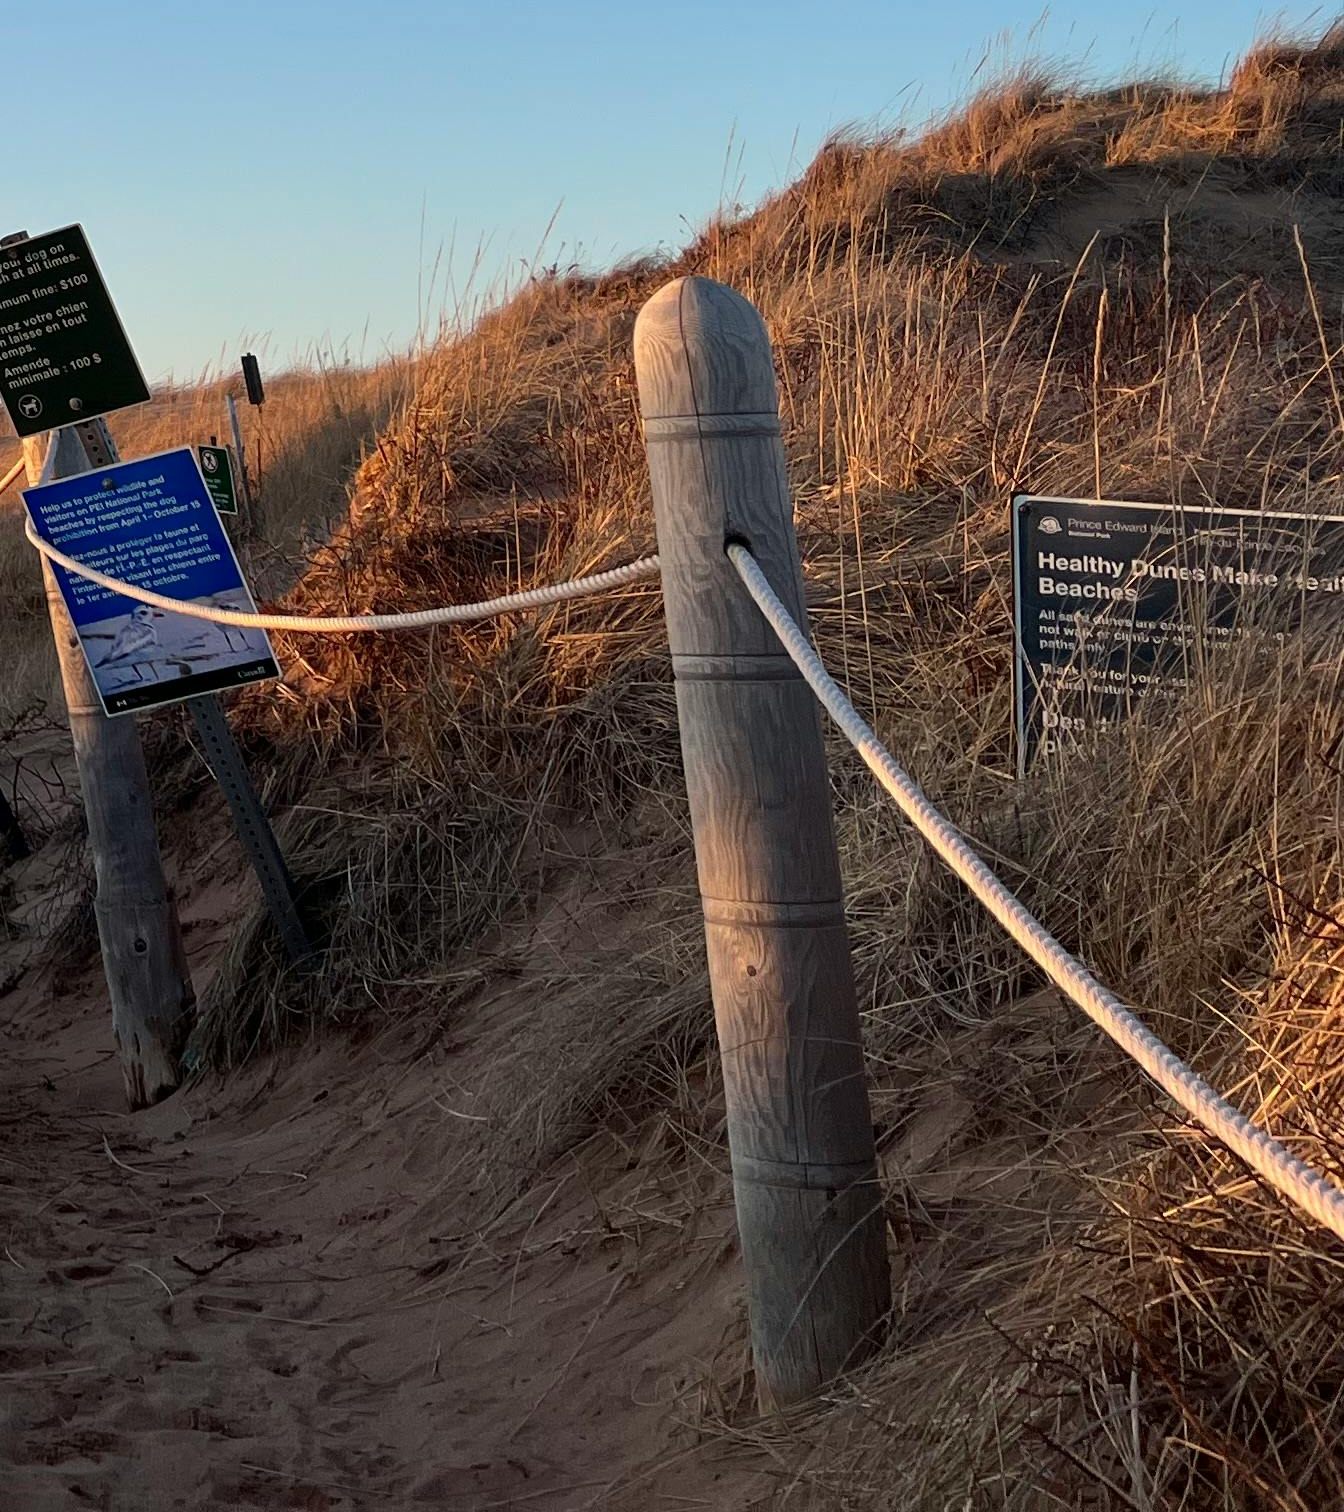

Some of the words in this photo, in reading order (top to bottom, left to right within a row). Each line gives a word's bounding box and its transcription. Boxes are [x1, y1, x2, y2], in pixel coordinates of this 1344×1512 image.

[12, 268, 25, 280] at
[27, 262, 42, 275] all
[42, 252, 80, 270] times.
[24, 250, 47, 263] dog
[49, 243, 65, 254] on
[32, 285, 59, 299] fine:
[59, 273, 88, 290] $100
[23, 312, 53, 327] votre
[56, 301, 88, 317] chien
[8, 329, 42, 344] laisse
[45, 322, 61, 333] en
[62, 313, 88, 328] tout
[4, 357, 50, 378] Amende
[8, 367, 60, 389] minimale
[70, 356, 91, 370] 100
[92, 353, 102, 364] $
[40, 505, 60, 515] Help
[73, 497, 83, 506] to
[84, 490, 115, 505] protect
[116, 480, 147, 493] wildlife
[148, 475, 165, 486] and
[44, 511, 75, 524] visitors
[76, 507, 88, 516] on
[105, 494, 140, 508] National
[141, 488, 162, 498] Park
[48, 518, 84, 534] beaches
[85, 516, 96, 525] by
[97, 504, 143, 522] respecting
[143, 500, 158, 509] the
[159, 496, 177, 506] dog
[52, 528, 98, 545] prohibition
[99, 522, 120, 532] from
[120, 516, 141, 528] April
[190, 499, 201, 509] 15
[1068, 518, 1102, 530] Prince
[1105, 520, 1147, 534] Edward
[164, 528, 189, 539] faune
[189, 524, 200, 532] et
[103, 567, 116, 576] de
[151, 556, 163, 565] en
[164, 544, 212, 562] respectant
[116, 554, 129, 562] sur
[131, 549, 144, 558] les
[145, 542, 175, 556] plages
[176, 538, 188, 546] du
[188, 532, 209, 545] parc
[126, 571, 152, 582] visant
[167, 558, 197, 571] chiens
[198, 553, 221, 565] entre
[1038, 552, 1124, 578] Healthy
[1132, 559, 1206, 582] Dunes
[76, 597, 85, 605] le
[86, 595, 101, 603] 1er
[142, 581, 152, 589] 15
[153, 573, 189, 587] octobre.
[1039, 577, 1138, 601] Beaches
[1039, 609, 1055, 620] All
[1136, 620, 1156, 629] are
[1039, 625, 1060, 635] not
[1039, 639, 1075, 650] paths
